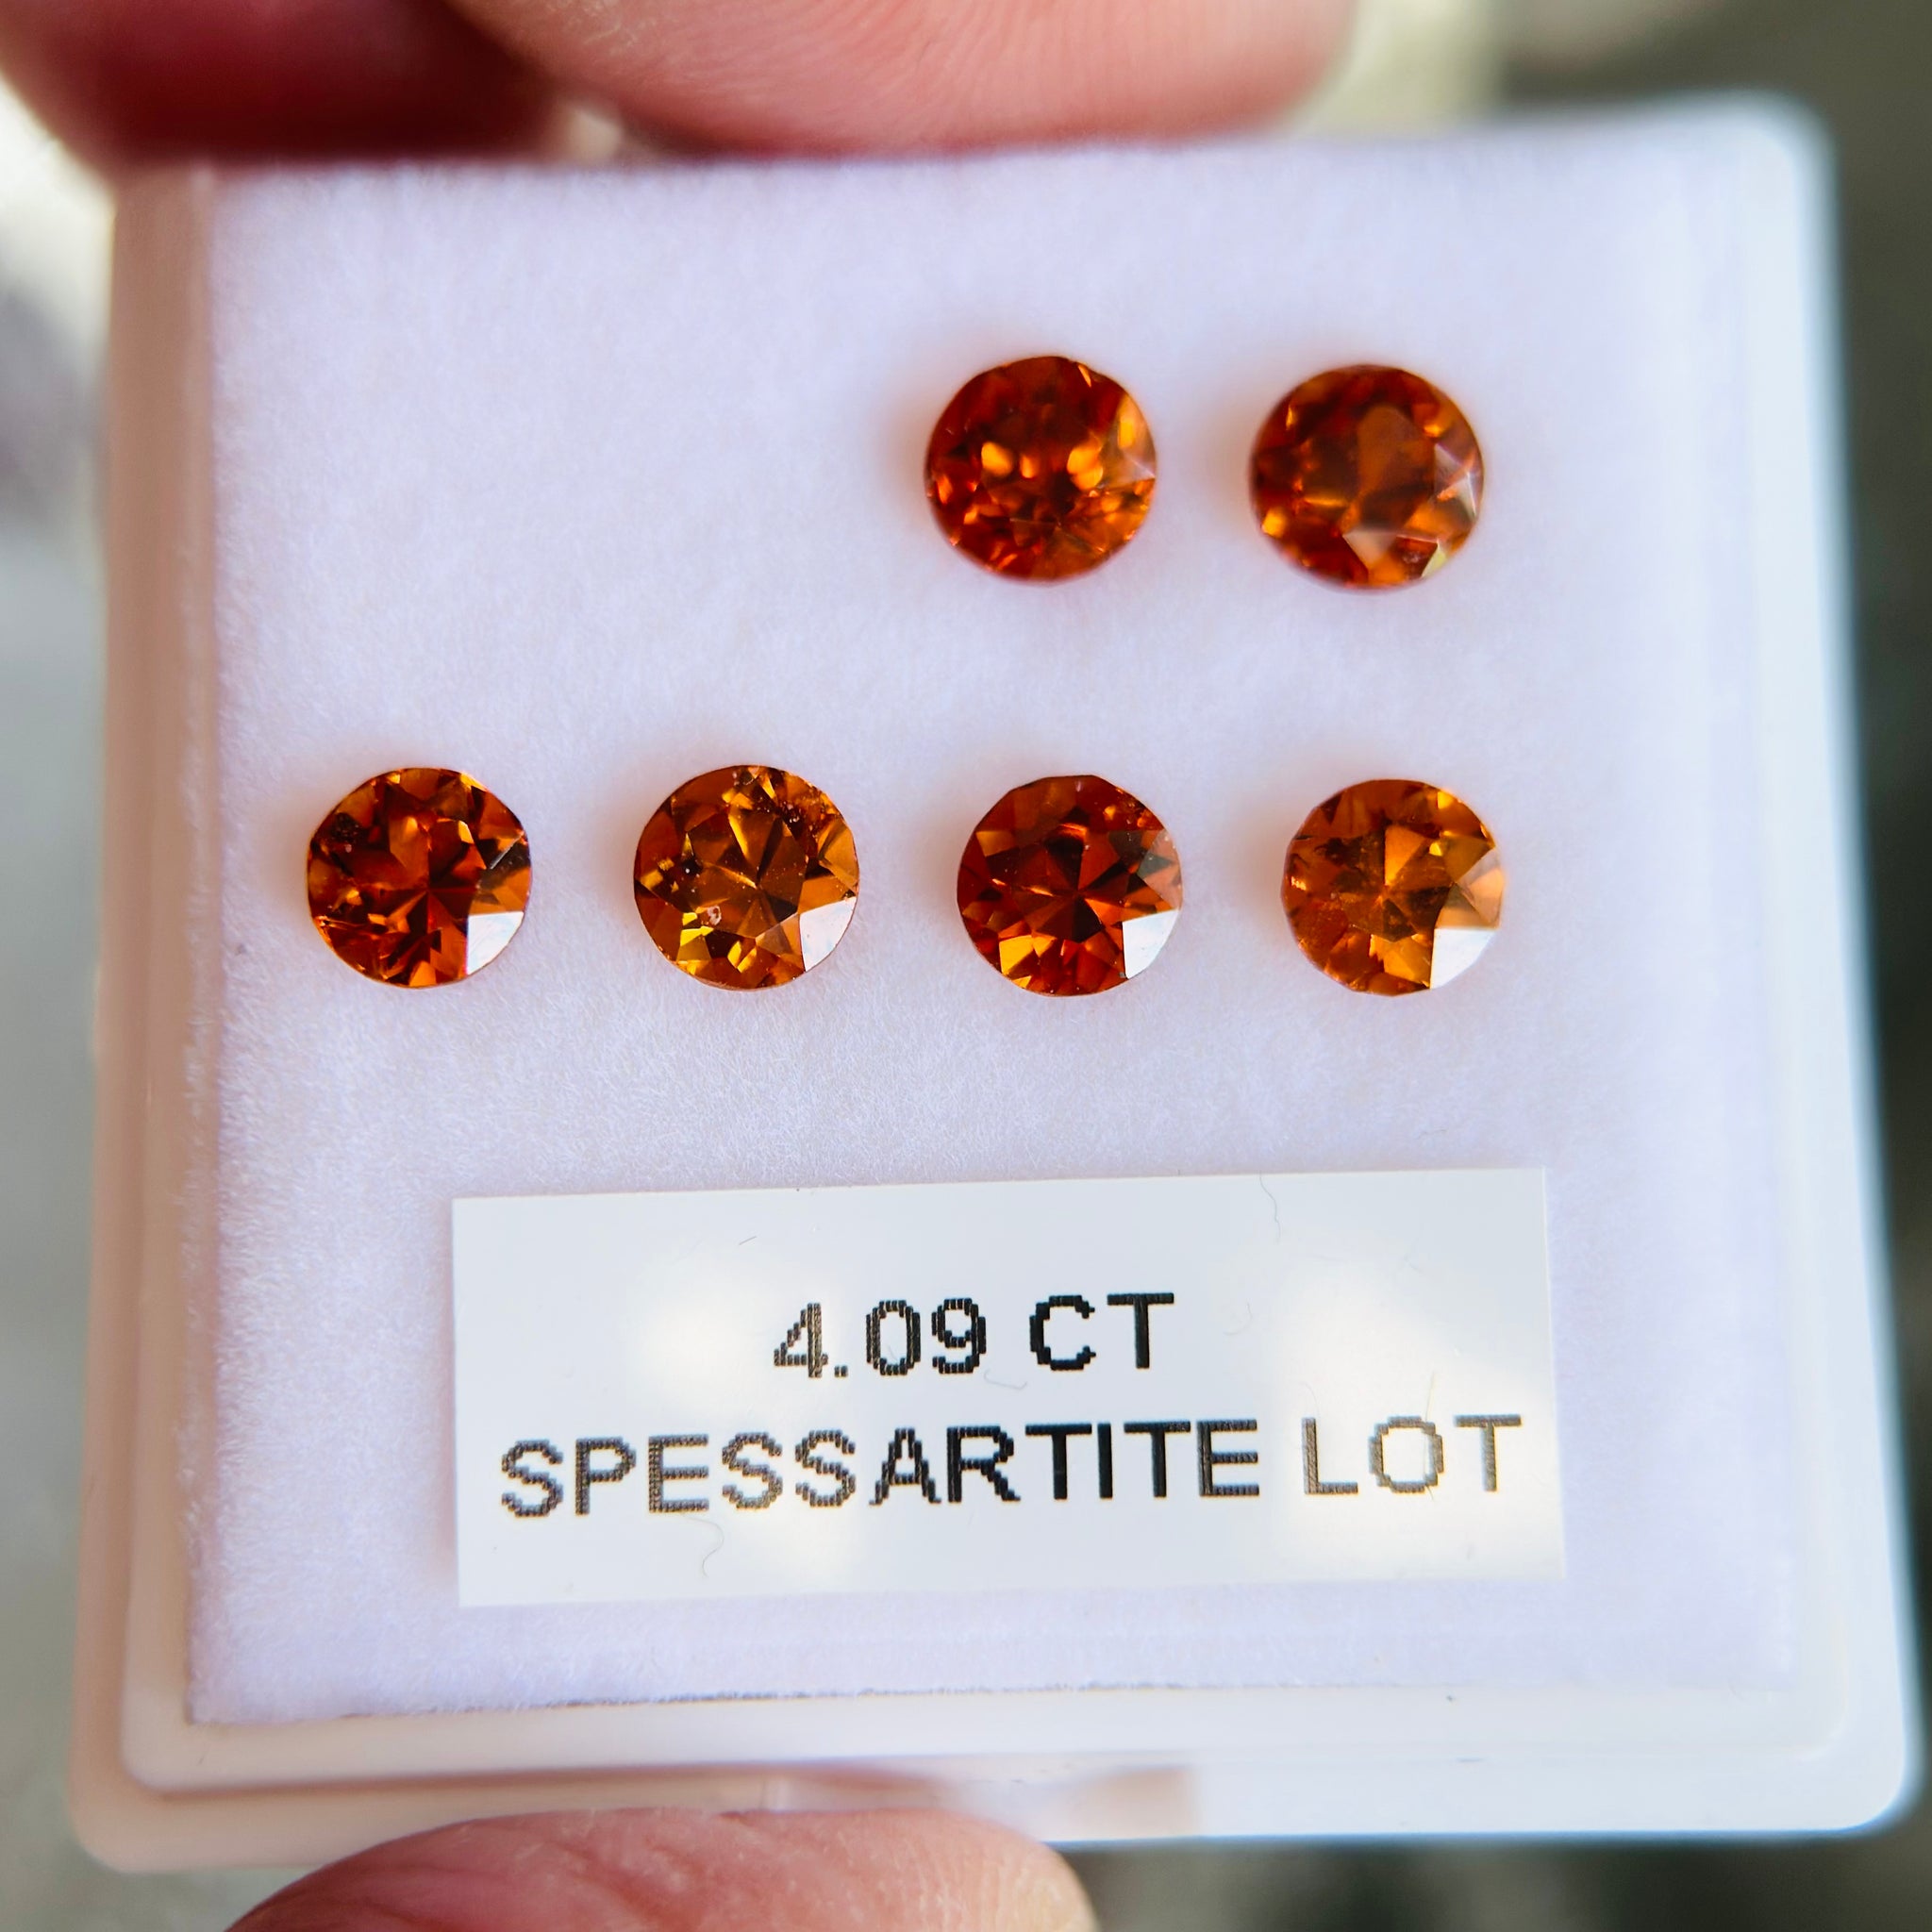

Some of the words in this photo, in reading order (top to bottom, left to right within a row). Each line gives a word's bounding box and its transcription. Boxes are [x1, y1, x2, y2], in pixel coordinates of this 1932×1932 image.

[773, 1297, 987, 1378] 4.09
[1028, 1291, 1175, 1372] CT
[500, 1418, 1260, 1518] SPESSARTITE
[1303, 1415, 1522, 1495] LOT
